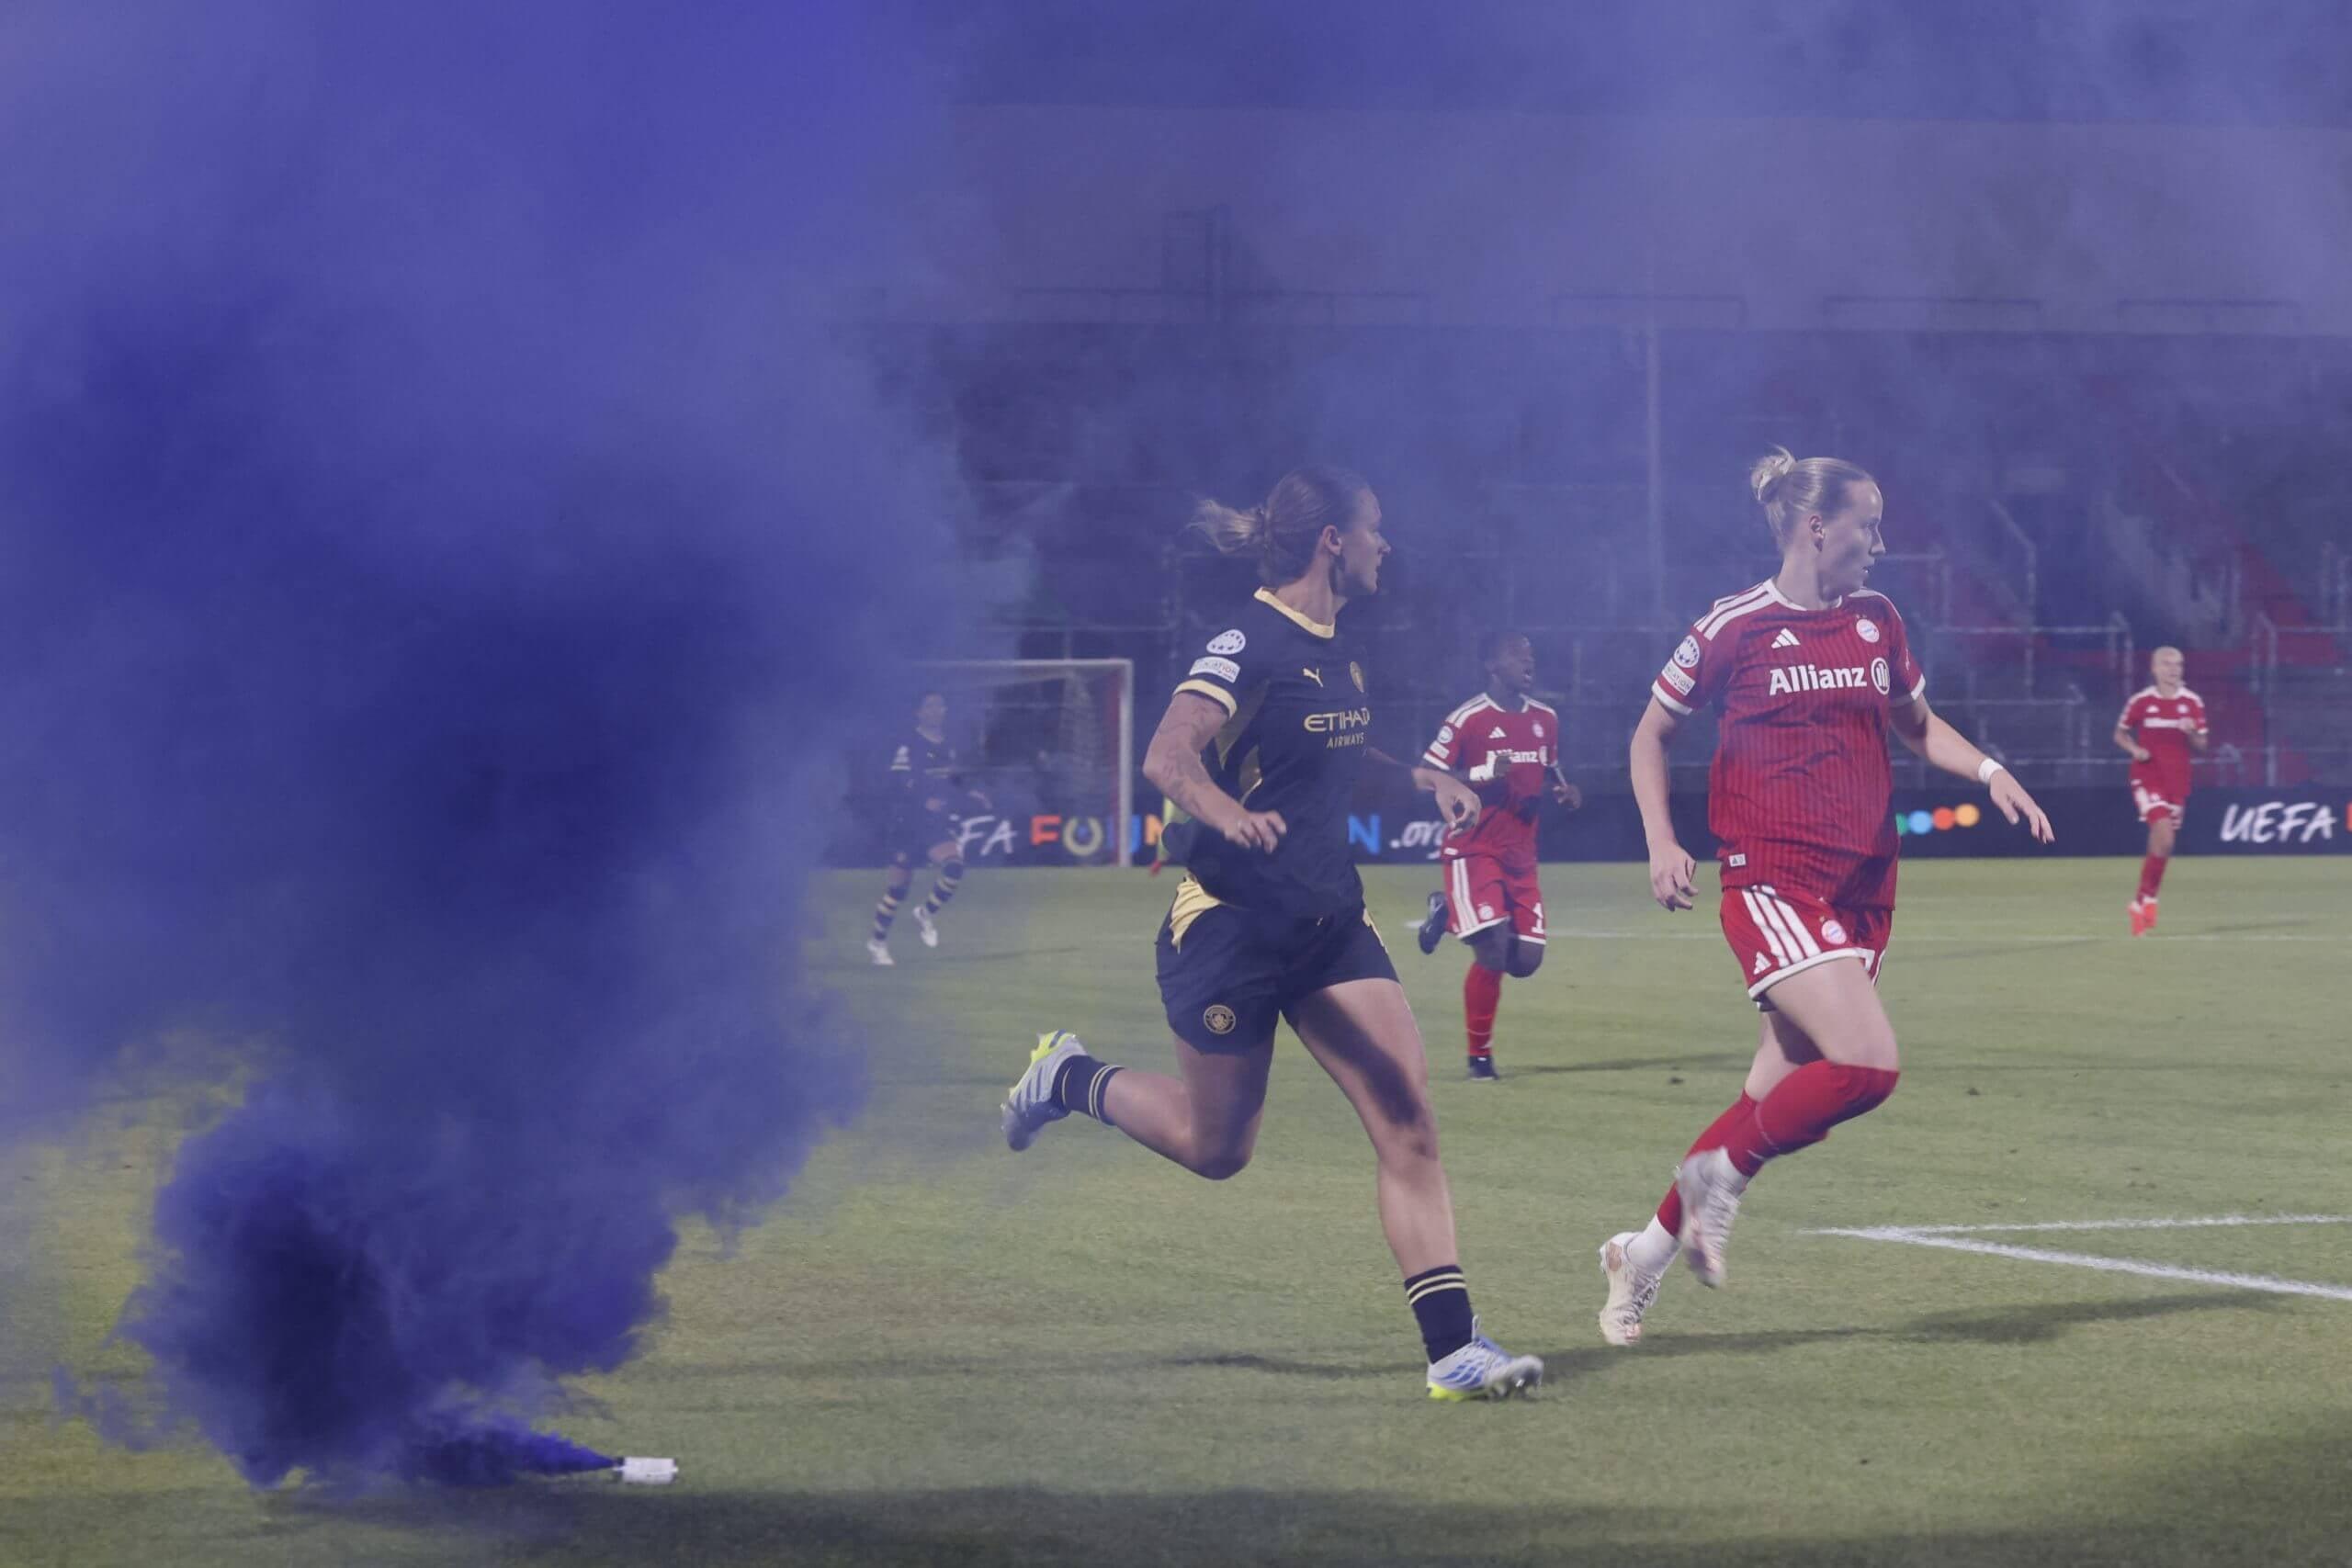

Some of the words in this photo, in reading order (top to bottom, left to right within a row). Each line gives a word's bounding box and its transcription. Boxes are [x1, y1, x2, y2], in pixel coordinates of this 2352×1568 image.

[1770, 664, 1867, 695] Allianz
[1304, 707, 1370, 732] ETIHAD
[1326, 732, 1364, 749] AIRWAYS
[2220, 801, 2338, 843] UEFA
